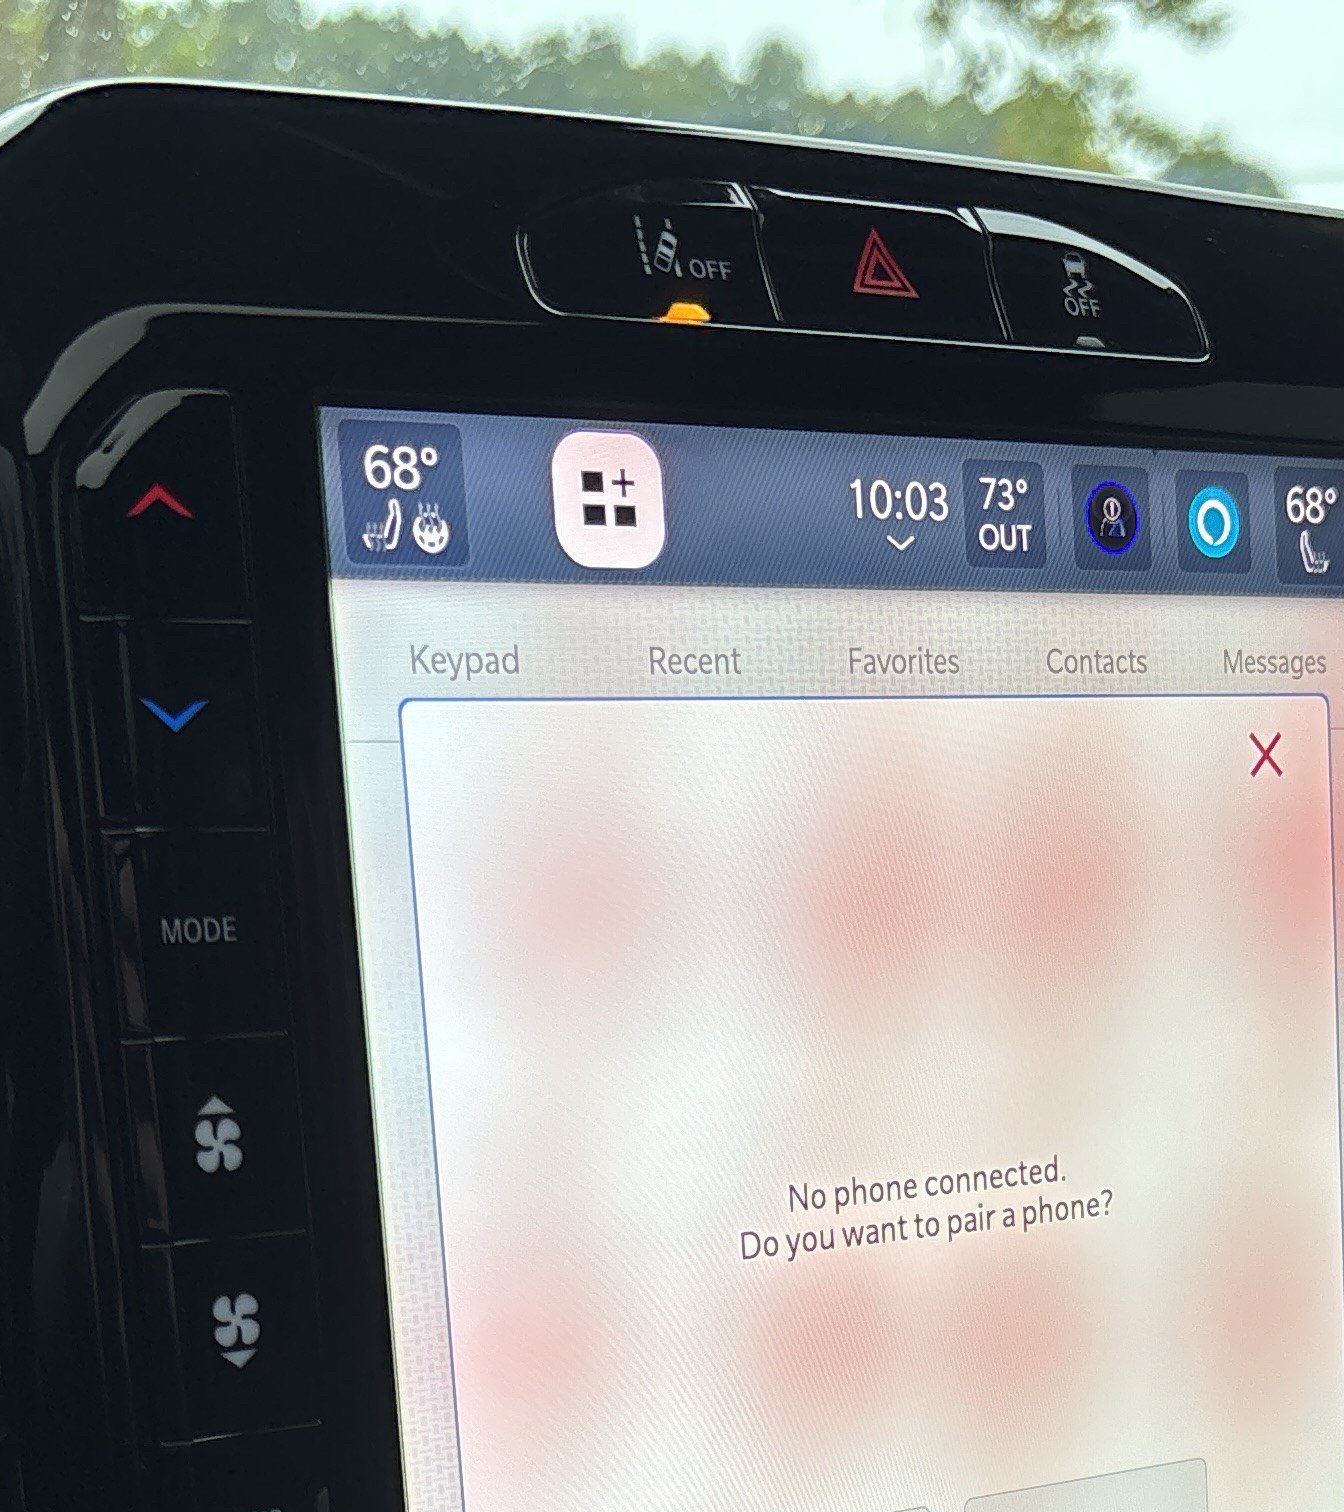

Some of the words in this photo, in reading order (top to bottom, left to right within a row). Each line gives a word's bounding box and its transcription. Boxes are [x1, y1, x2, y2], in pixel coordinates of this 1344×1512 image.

[689, 258, 732, 282] OFF
[1063, 297, 1101, 318] OFF
[362, 443, 439, 491] 68°
[849, 477, 949, 522] 10:03
[977, 476, 1029, 512] 73°
[1284, 485, 1338, 526] 68°
[977, 523, 1032, 553] OUT
[409, 643, 521, 681] Keypad
[648, 645, 743, 676] Recent
[848, 647, 961, 676] Favorites
[1045, 648, 1149, 676] Contacts
[1222, 649, 1329, 685] Messages
[159, 914, 238, 945] MODE
[788, 1182, 827, 1213] No
[834, 1176, 919, 1214] phone
[924, 1153, 1067, 1198] connected.
[740, 1229, 780, 1261] Do
[785, 1227, 836, 1262] you
[841, 1212, 908, 1250] want
[913, 1213, 941, 1239] to
[947, 1203, 997, 1243] pair
[1001, 1206, 1017, 1229] a
[1022, 1188, 1115, 1234] phone?
